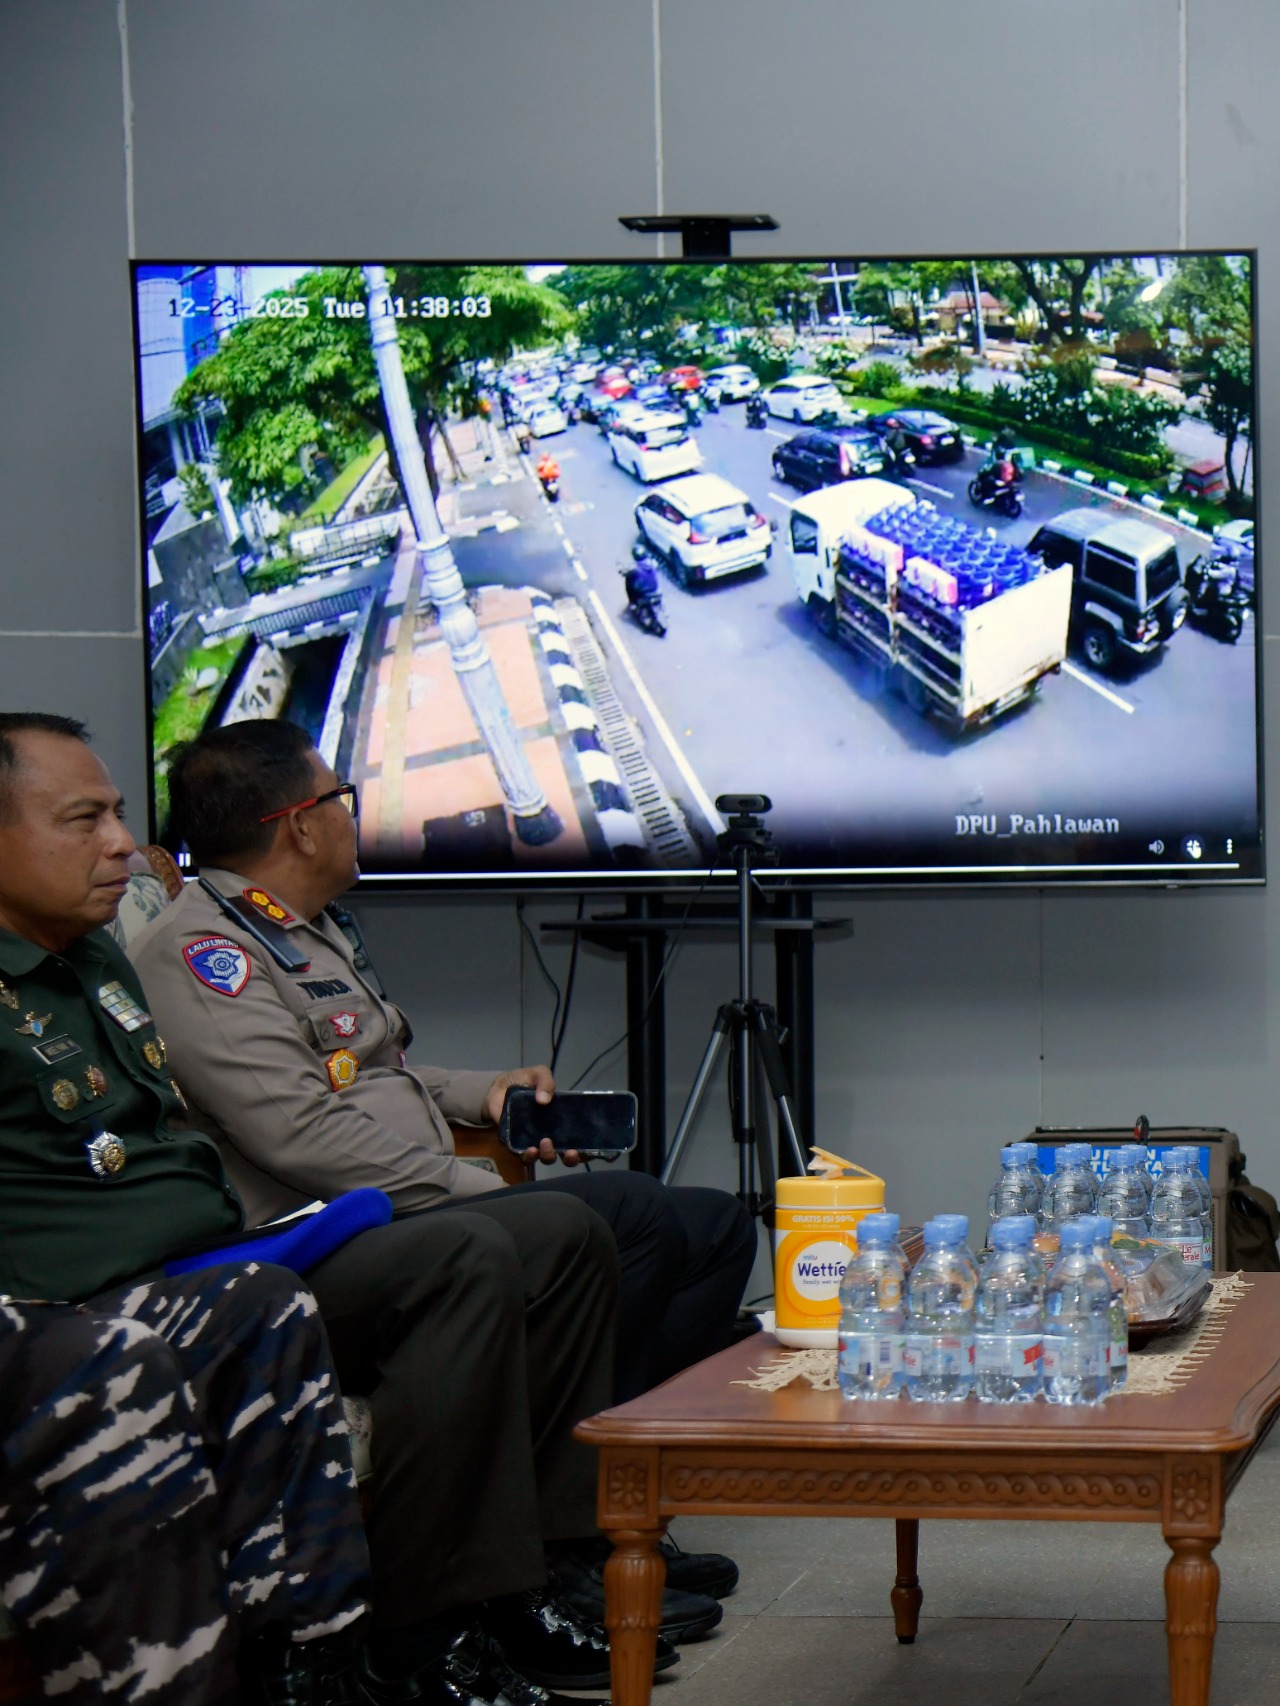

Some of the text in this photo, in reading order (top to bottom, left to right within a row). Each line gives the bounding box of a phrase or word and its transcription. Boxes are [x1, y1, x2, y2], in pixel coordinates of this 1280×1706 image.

[168, 296, 492, 318] 12-23-2025 Tue 11:38:03
[955, 814, 1120, 838] DPU_Pahlawan
[188, 940, 210, 955] LALU
[792, 1214, 855, 1223] GRATIS ISI 50%
